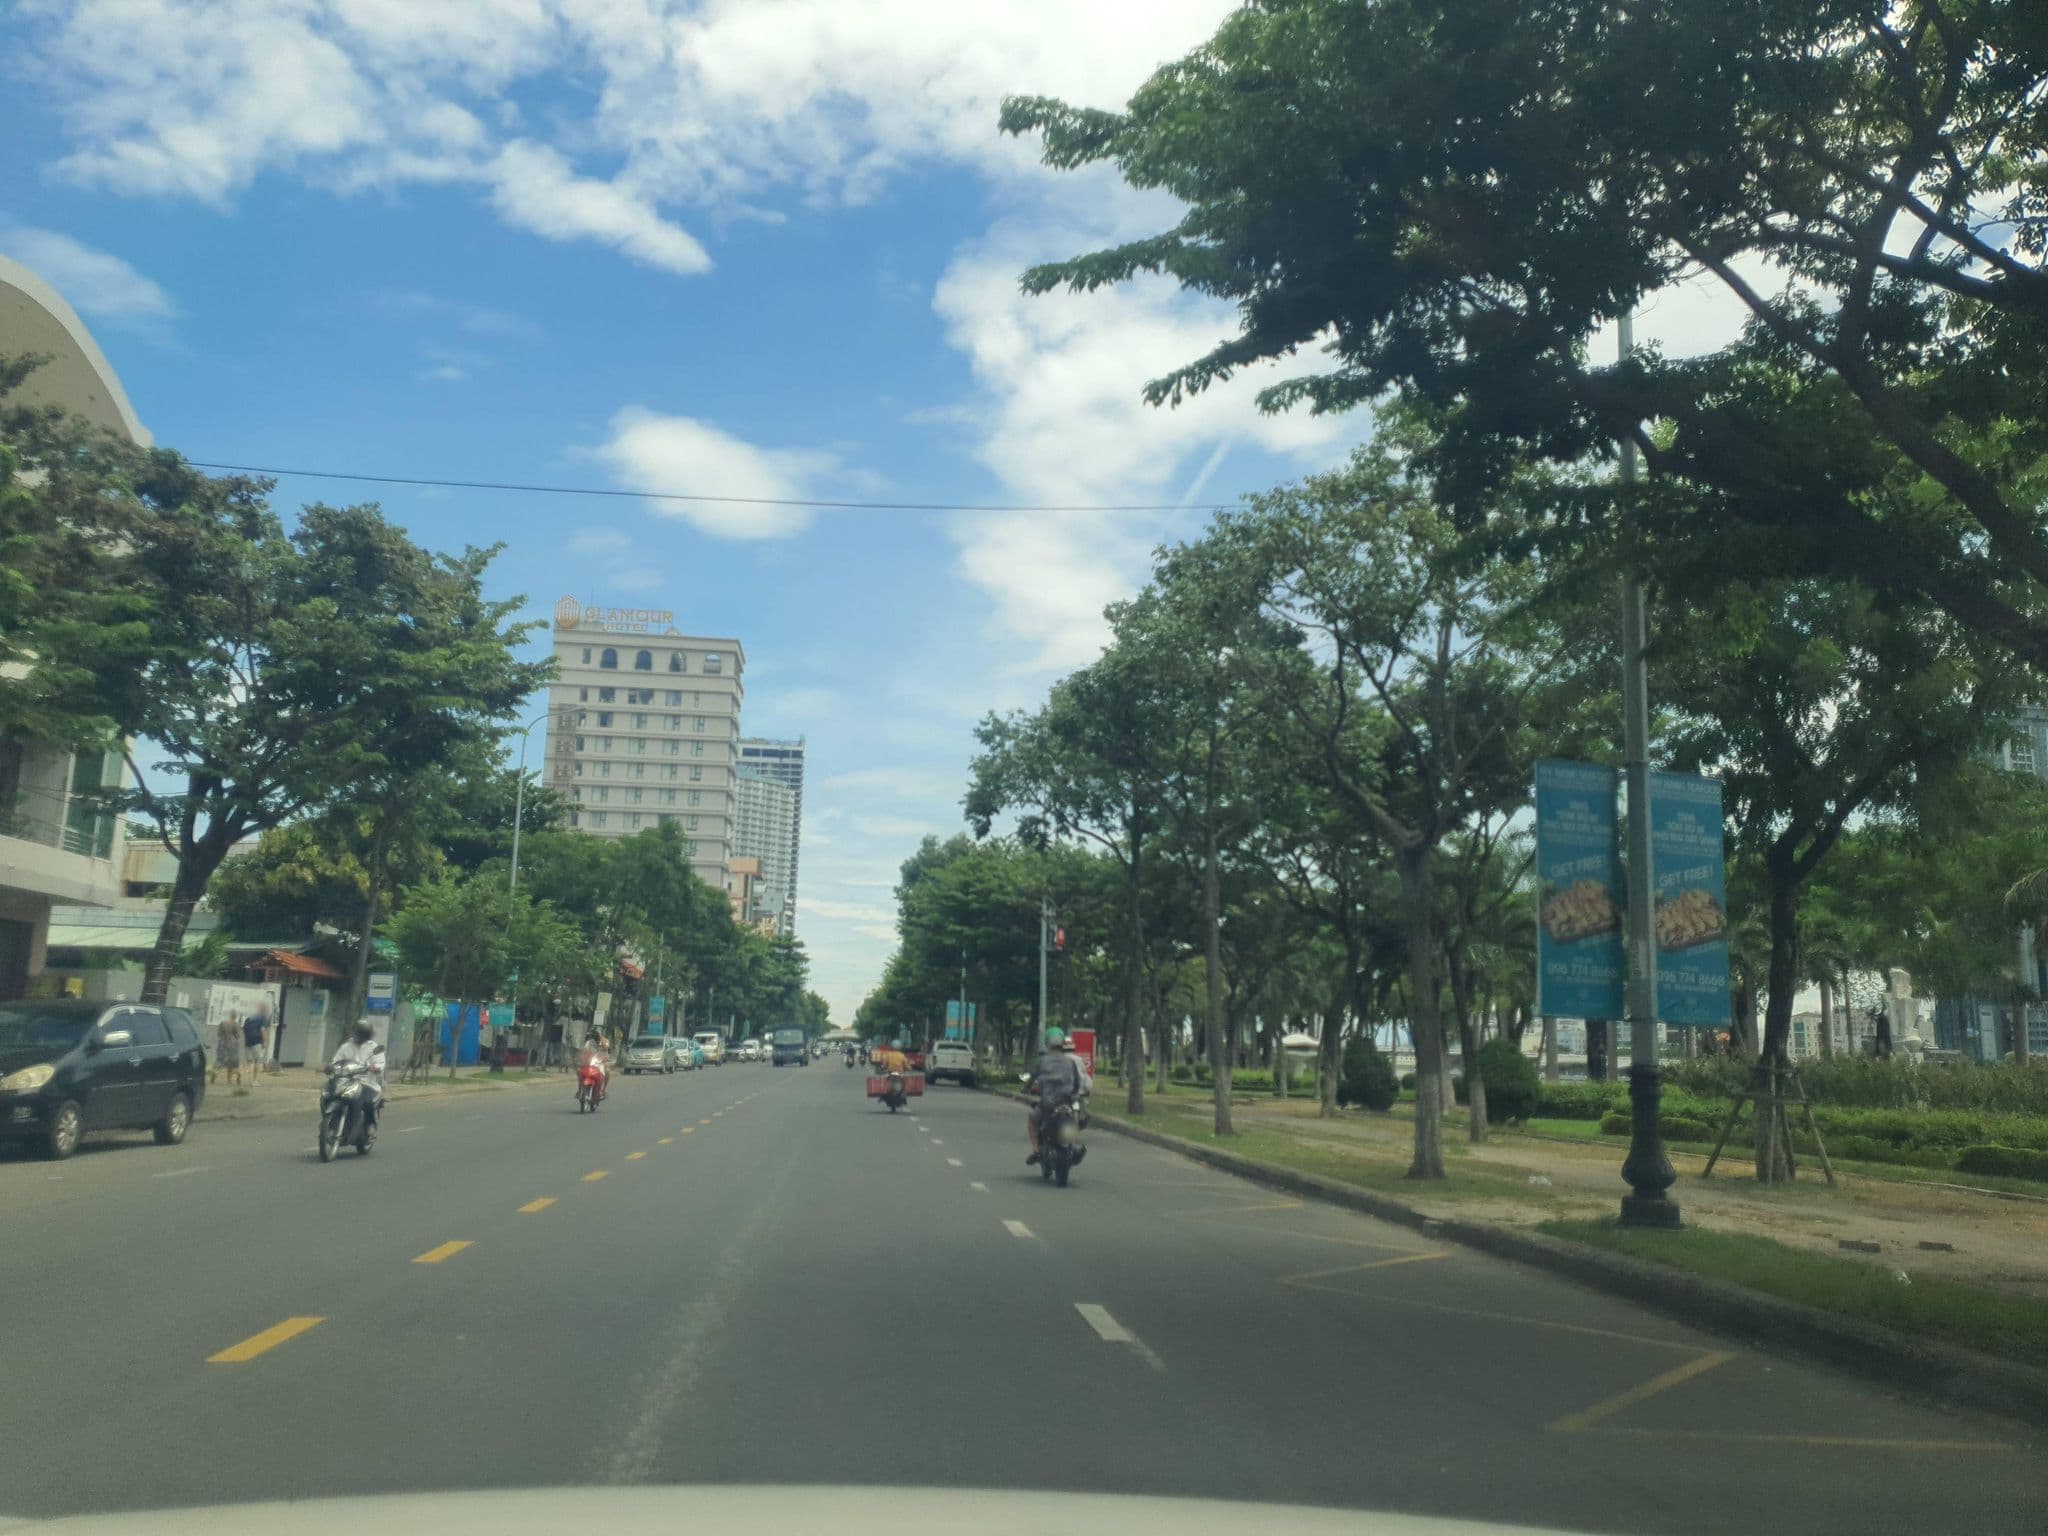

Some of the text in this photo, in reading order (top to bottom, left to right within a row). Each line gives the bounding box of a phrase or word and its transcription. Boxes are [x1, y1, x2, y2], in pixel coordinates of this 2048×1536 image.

[585, 607, 674, 624] GLAMOUR
[1551, 861, 1574, 878] GET
[1659, 871, 1681, 888] GET
